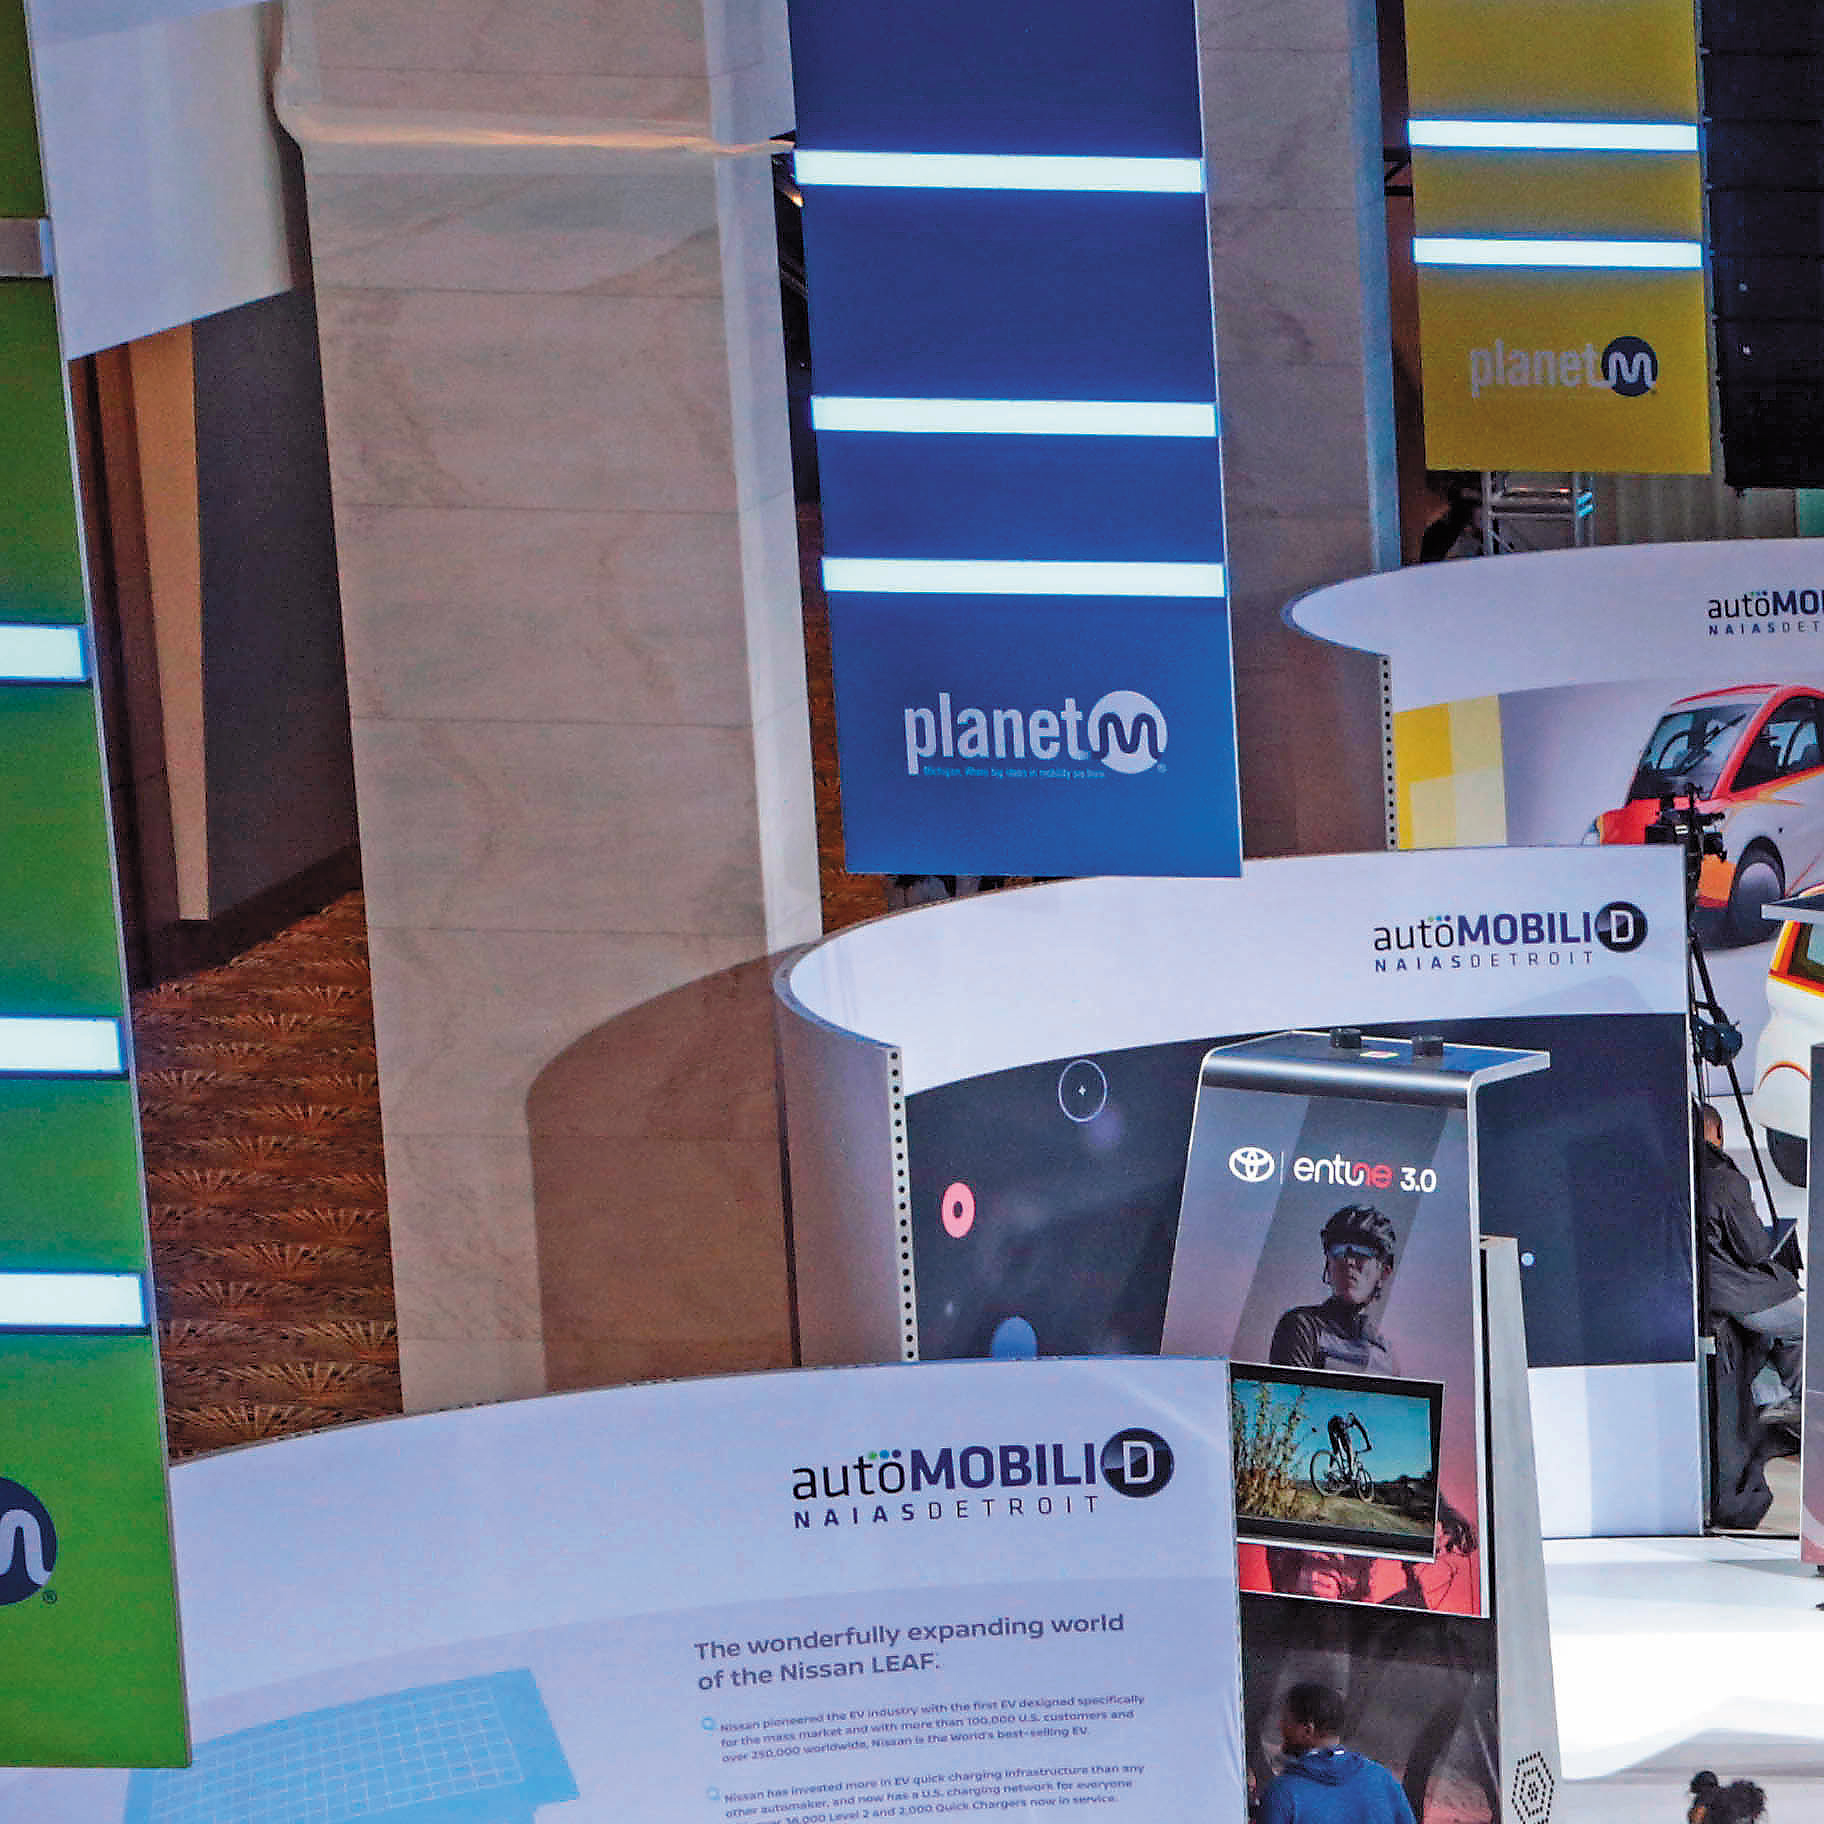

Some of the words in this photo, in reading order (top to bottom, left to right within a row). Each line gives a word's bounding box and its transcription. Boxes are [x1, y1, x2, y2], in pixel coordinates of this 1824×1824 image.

[1294, 1153, 1393, 1190] entune
[1400, 1167, 1437, 1192] 3.0
[694, 1640, 740, 1660] The
[748, 1625, 900, 1653] wonderfully
[908, 1616, 1044, 1643] expanding
[1051, 1613, 1125, 1632] world
[698, 1671, 725, 1691] of
[731, 1667, 772, 1687] the
[780, 1658, 864, 1682] Nissan
